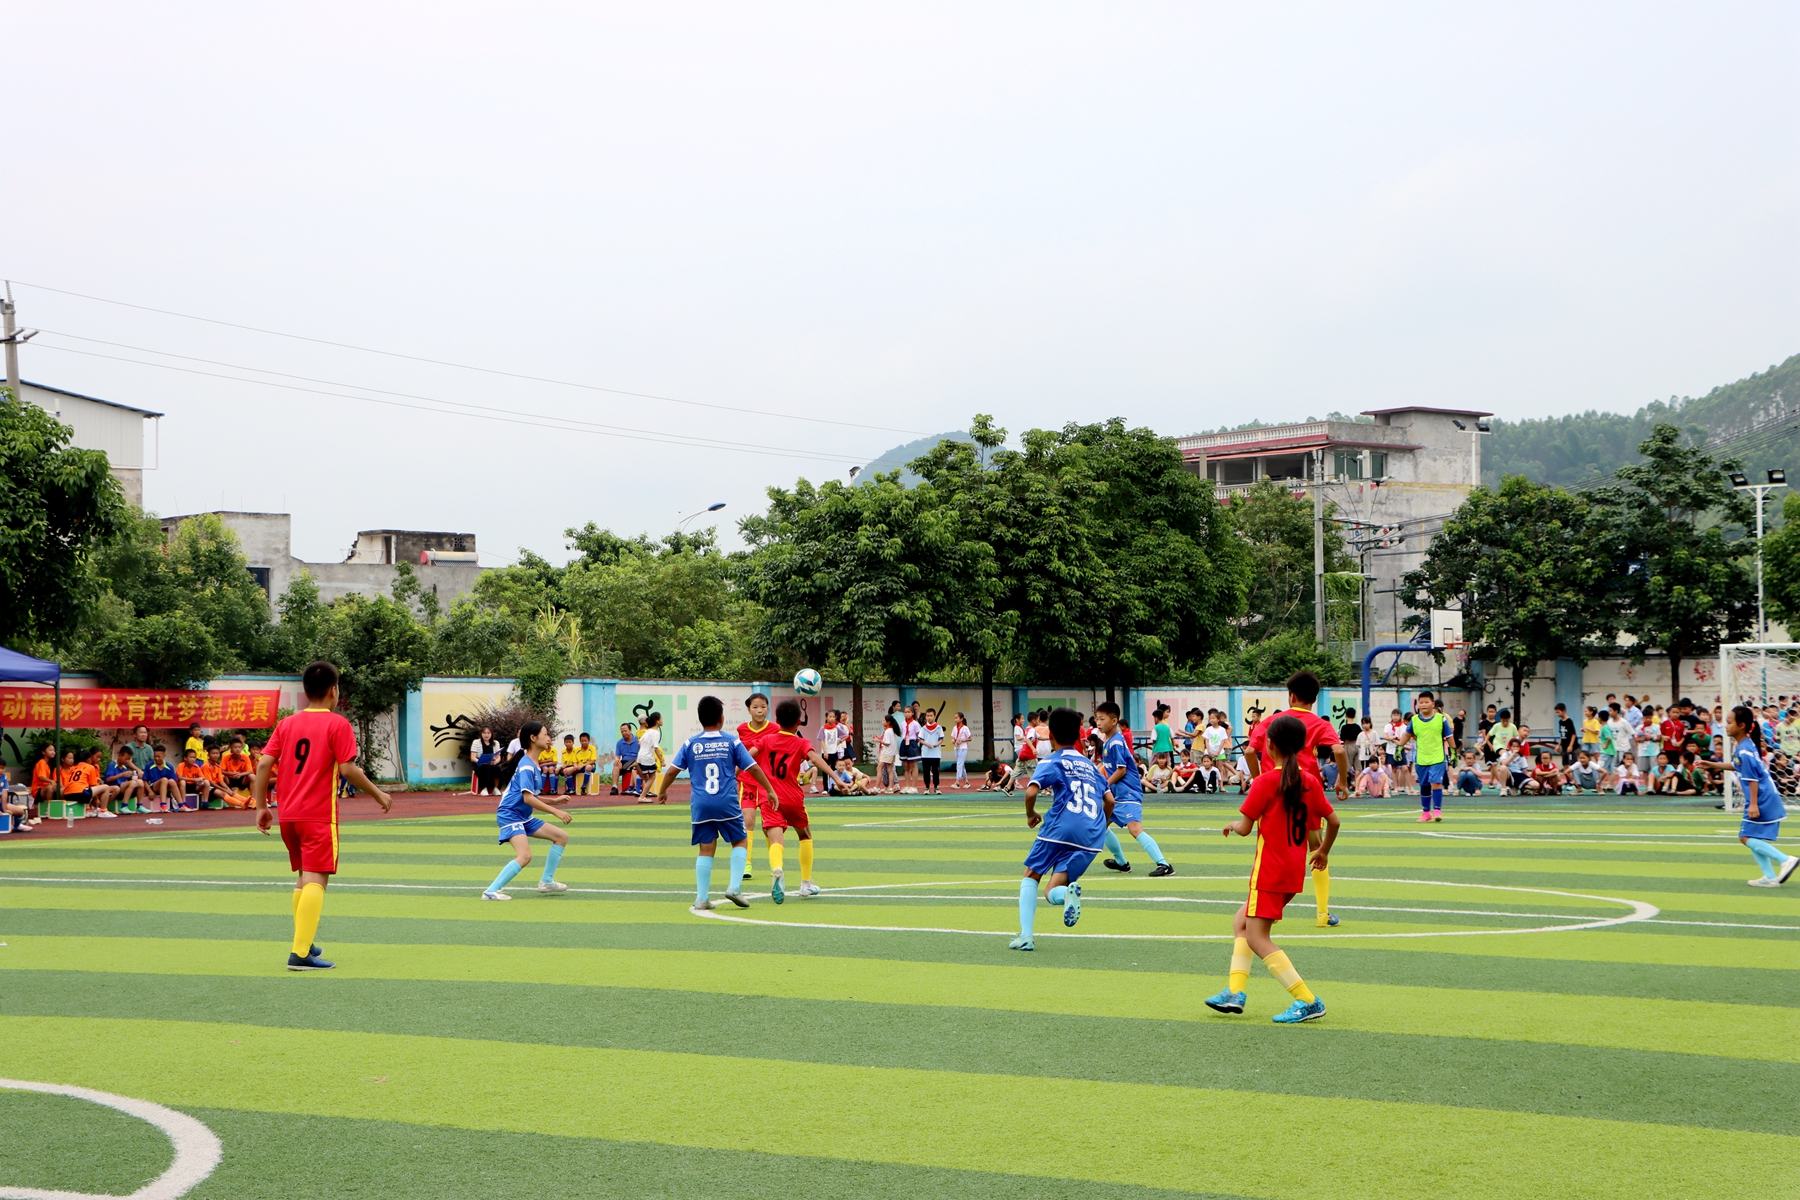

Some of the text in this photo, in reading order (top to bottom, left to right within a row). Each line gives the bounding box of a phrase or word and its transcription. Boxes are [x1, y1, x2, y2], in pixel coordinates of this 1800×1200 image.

[2, 692, 272, 722] 动精彩 体育让梦想成真
[294, 738, 310, 775] 9
[768, 751, 790, 780] 16
[68, 770, 82, 782] 18
[705, 763, 719, 794] 8
[1066, 780, 1097, 819] 35
[1285, 801, 1308, 847] 18
